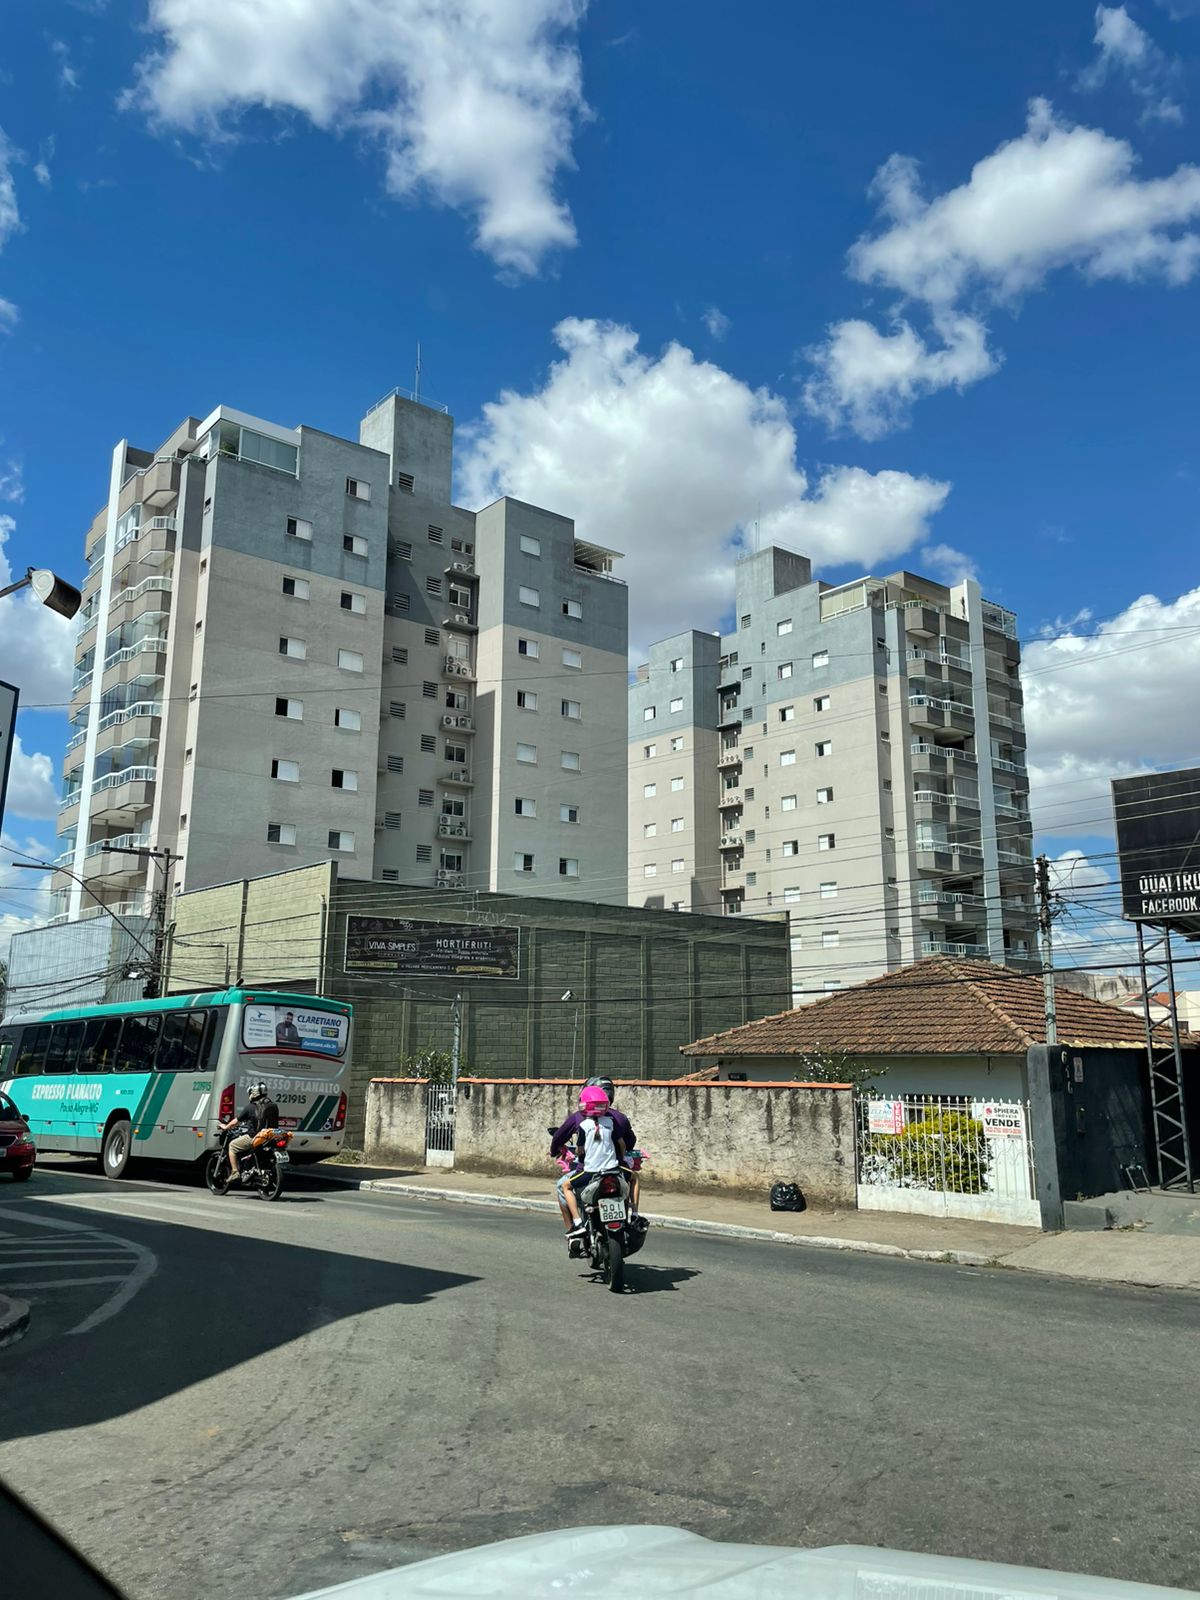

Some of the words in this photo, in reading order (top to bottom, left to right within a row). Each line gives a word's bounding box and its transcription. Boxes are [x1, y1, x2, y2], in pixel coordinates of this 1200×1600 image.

[368, 940, 386, 949] VIVA
[387, 942, 416, 952] SIMPLES
[297, 1015, 342, 1027] CLARETIANO
[32, 1084, 65, 1100] EXPRESSO
[65, 1083, 103, 1100] PLANALTO
[295, 1080, 341, 1094] PLANALTO
[275, 1093, 307, 1105] 221915
[894, 1102, 902, 1134] VENDE
[984, 1118, 1021, 1128] VENDE
[603, 1211, 624, 1220] 8820
